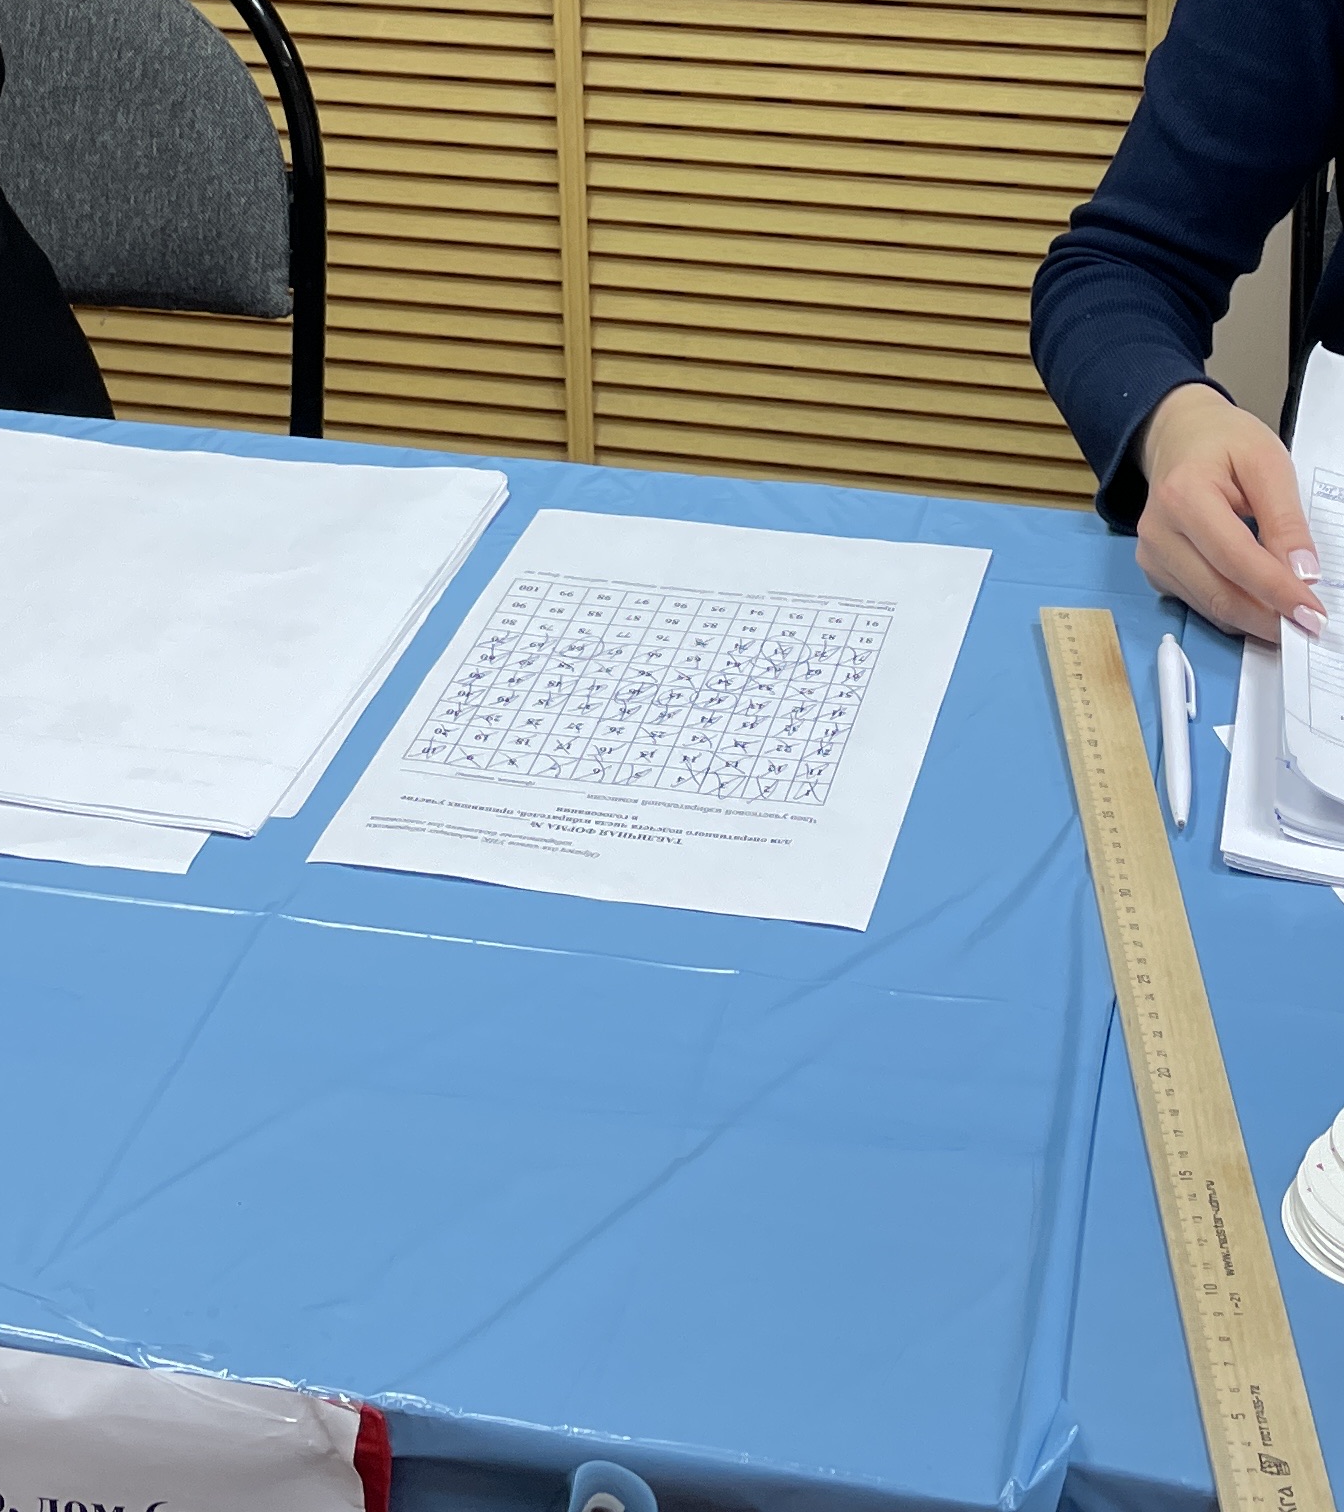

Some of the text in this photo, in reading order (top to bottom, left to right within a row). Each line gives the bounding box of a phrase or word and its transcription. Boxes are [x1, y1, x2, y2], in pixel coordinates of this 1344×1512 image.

[1158, 1068, 1172, 1080] 20
[1179, 1170, 1193, 1181] 15
[1203, 1283, 1217, 1295] 10
